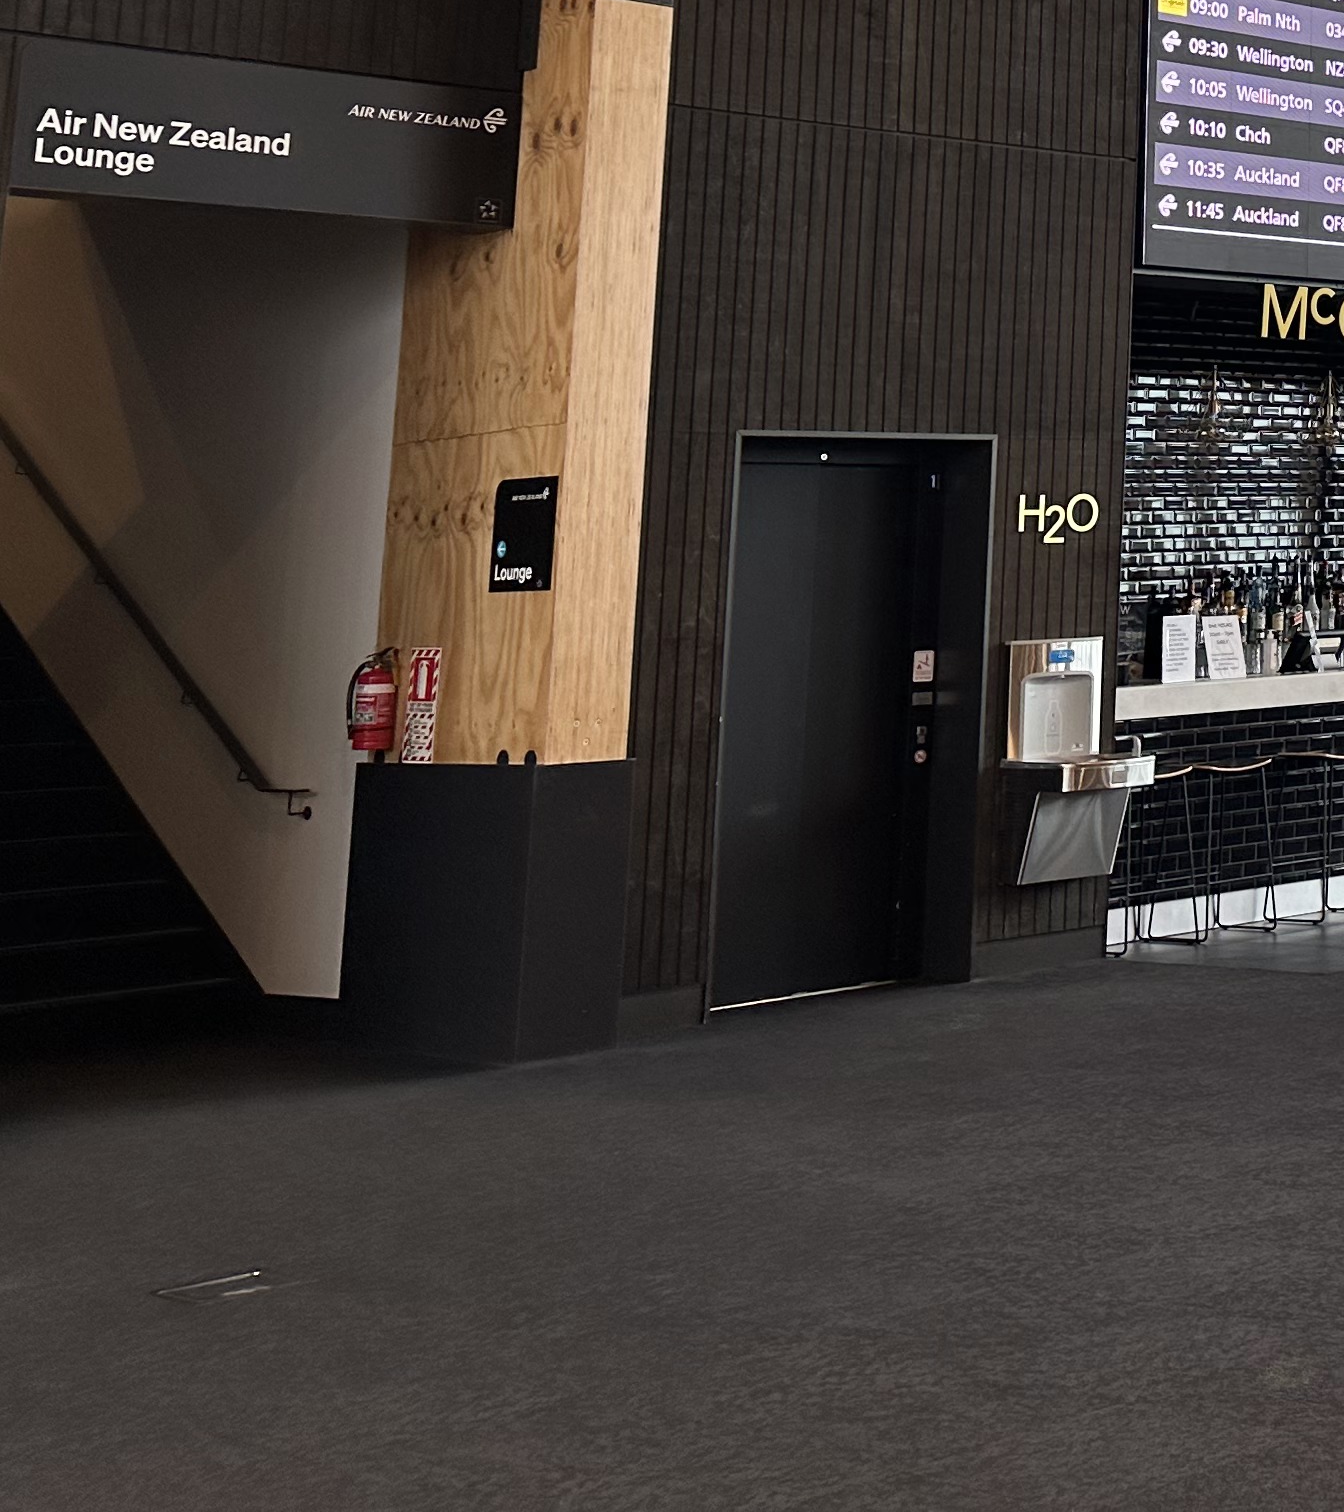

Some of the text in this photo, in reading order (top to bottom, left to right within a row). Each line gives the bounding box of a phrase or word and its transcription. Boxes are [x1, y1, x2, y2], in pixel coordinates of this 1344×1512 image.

[1238, 6, 1272, 28] Palm
[1276, 12, 1301, 32] Nth
[1189, 38, 1228, 59] 09:30
[1237, 45, 1313, 74] Wellington
[1189, 79, 1227, 98] 10:05
[1236, 85, 1313, 112] Wellington
[348, 103, 481, 130] AIR NEW ZEALAND
[36, 108, 291, 156] Air New Zealand
[1188, 119, 1226, 138] 10:10
[1235, 126, 1271, 146] Chch
[34, 138, 155, 176] Lounge
[1188, 160, 1225, 179] 10:35
[1234, 166, 1300, 188] Auckland
[1186, 201, 1224, 220] 11:45
[1232, 206, 1299, 227] Auckland
[1018, 493, 1099, 543] H2O
[494, 564, 532, 583] Lounge
